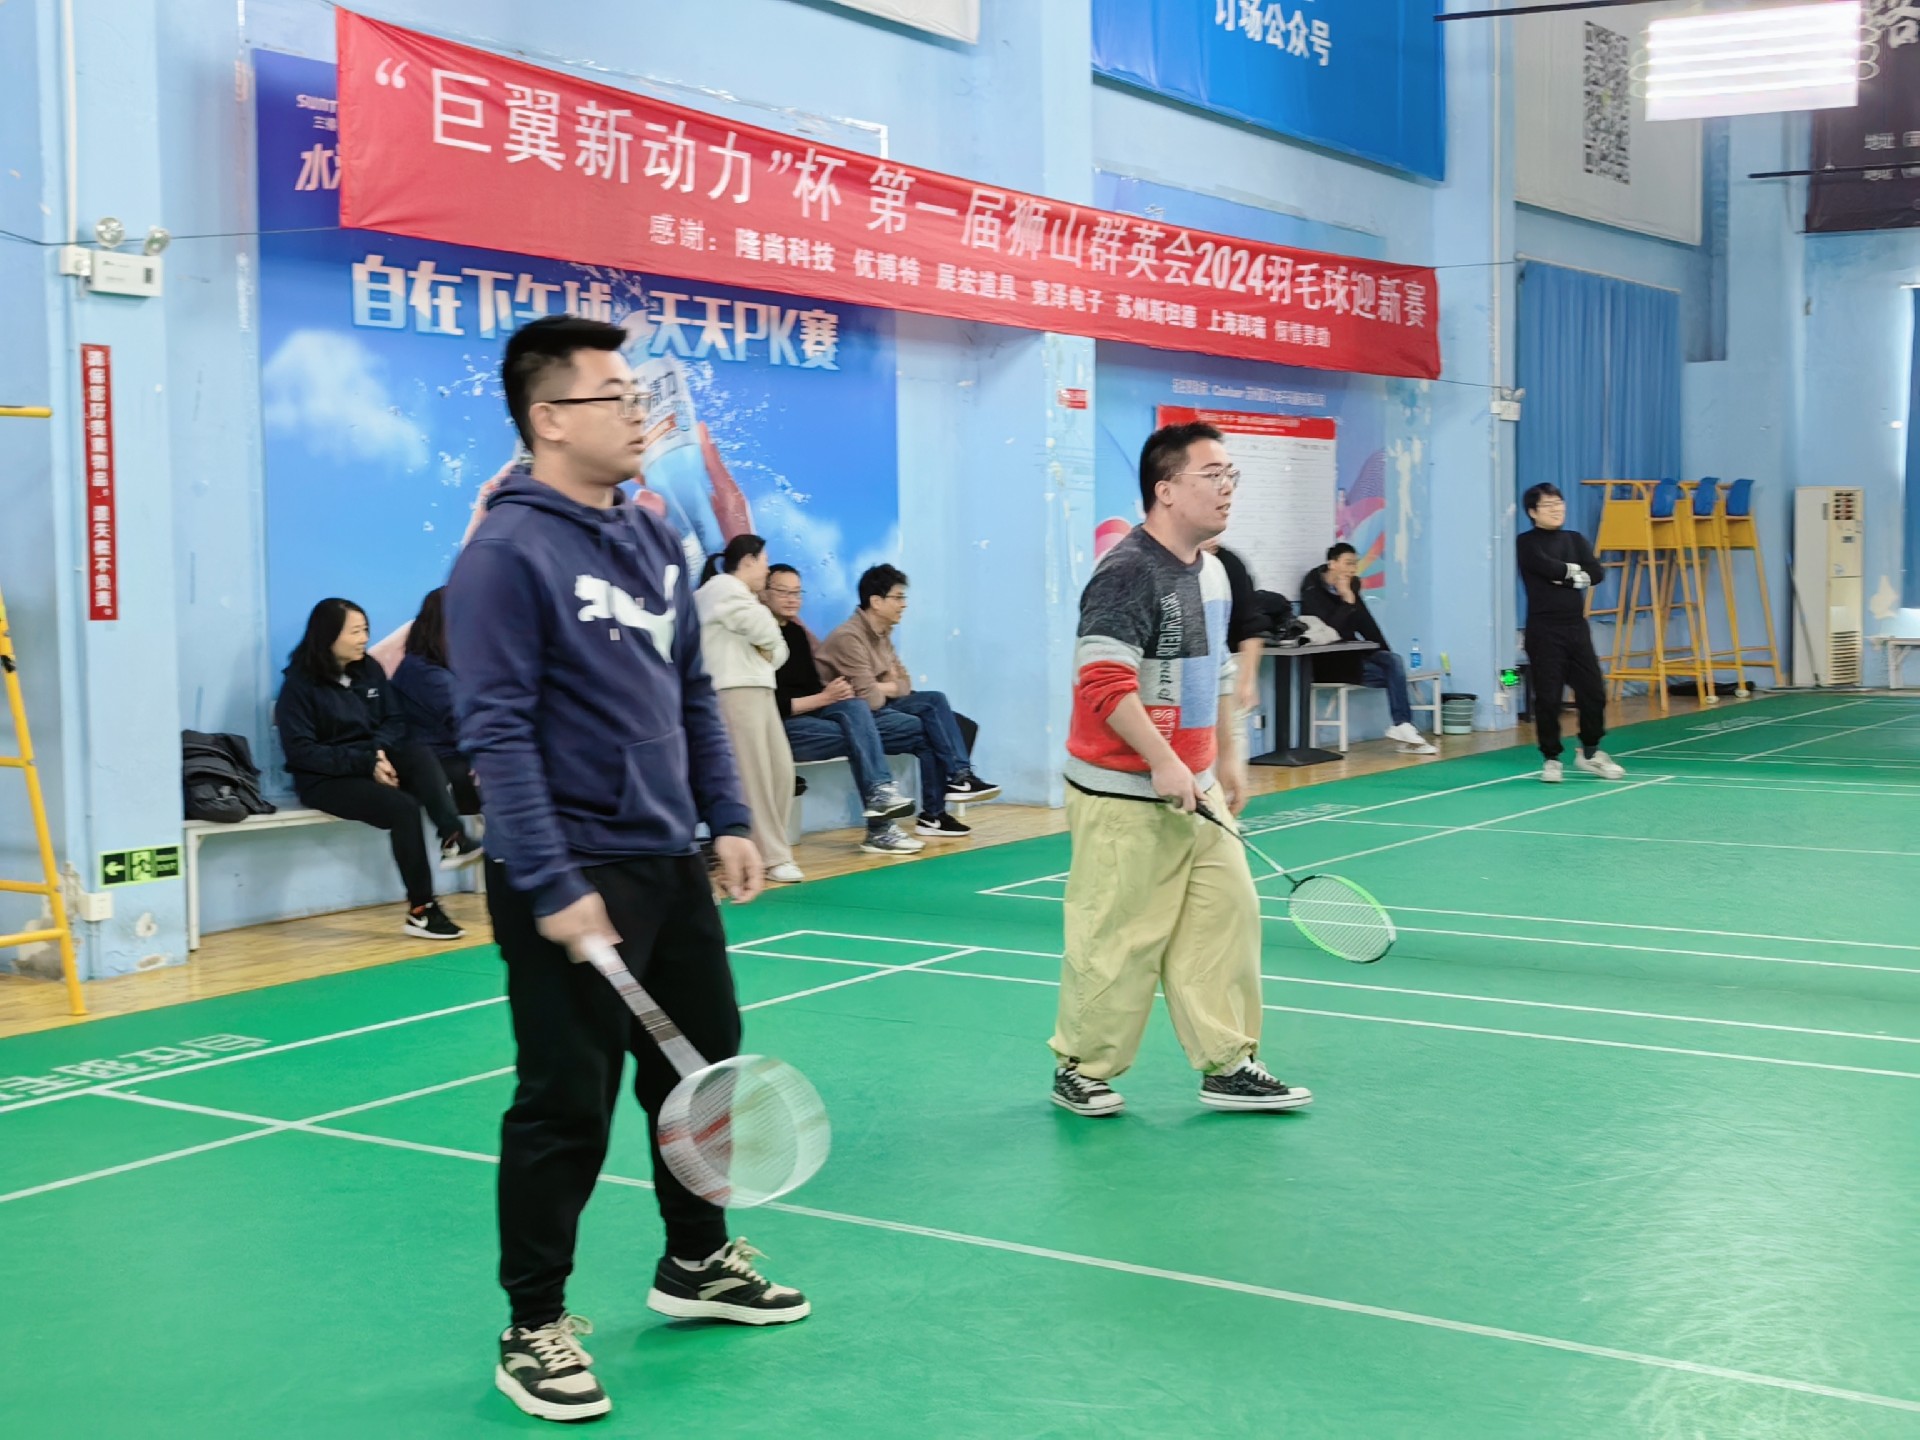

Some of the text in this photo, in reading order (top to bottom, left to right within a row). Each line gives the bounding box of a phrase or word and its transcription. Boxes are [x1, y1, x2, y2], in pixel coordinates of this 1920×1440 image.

[294, 143, 341, 191] 水
[735, 227, 836, 272] 隆尚科技
[648, 290, 840, 371] 天天PK赛
